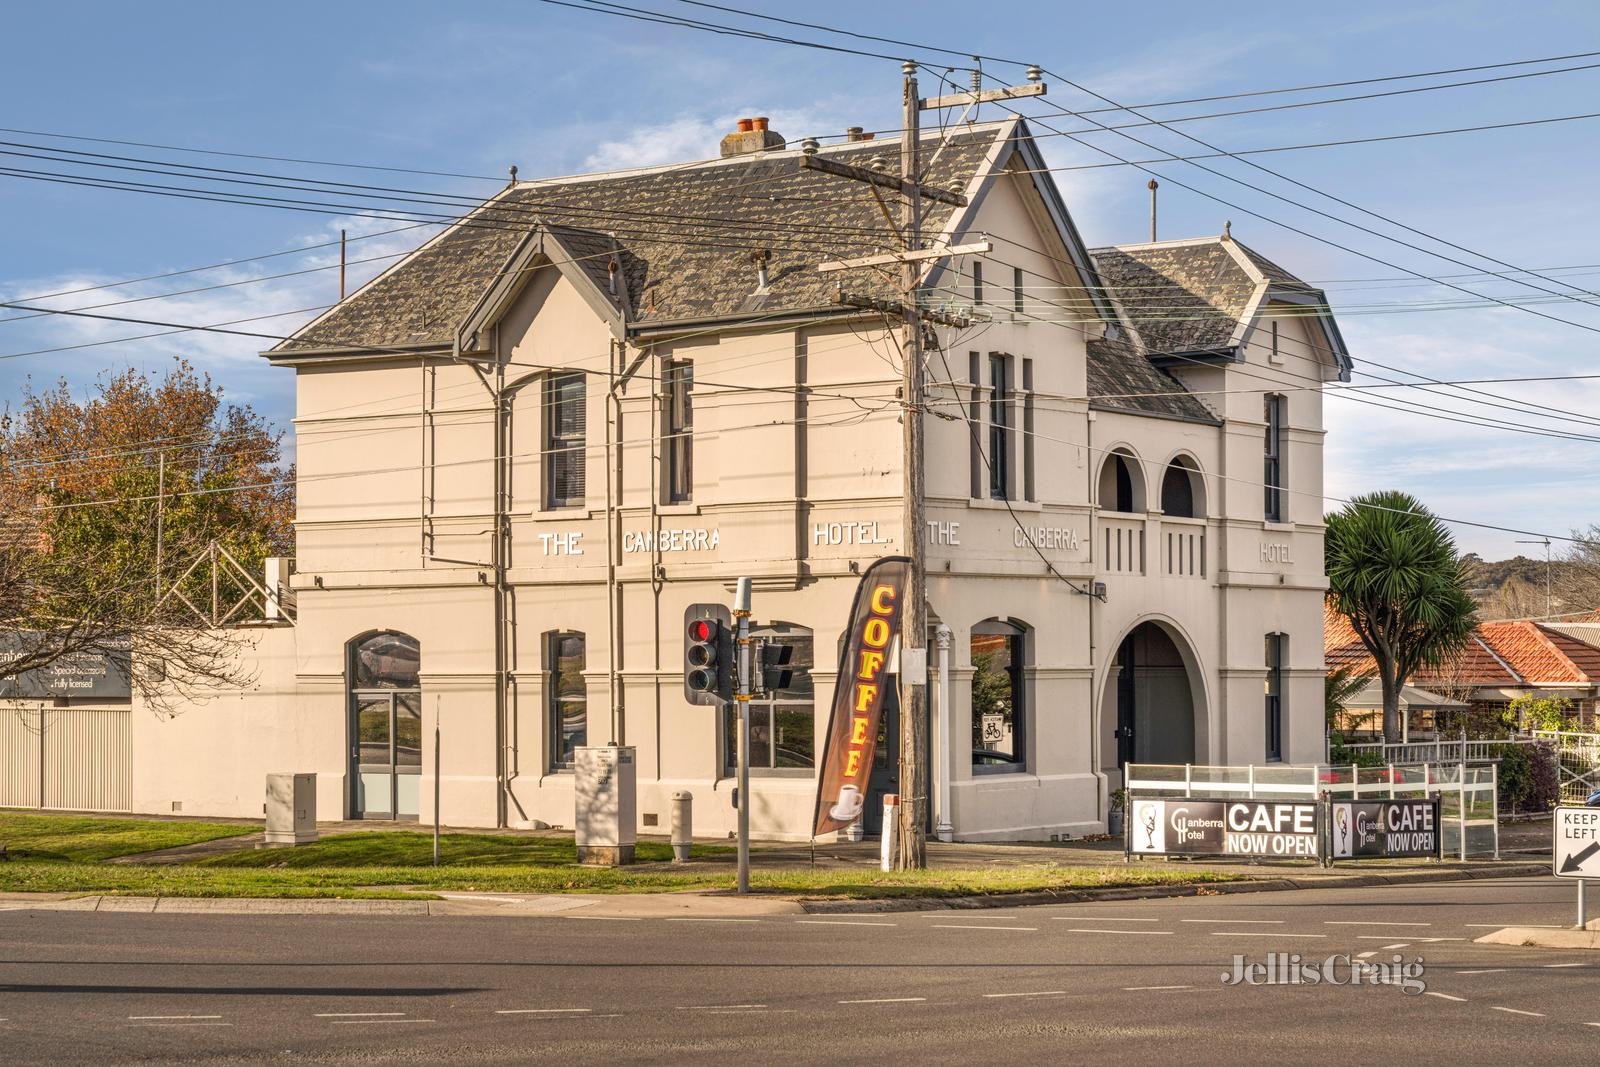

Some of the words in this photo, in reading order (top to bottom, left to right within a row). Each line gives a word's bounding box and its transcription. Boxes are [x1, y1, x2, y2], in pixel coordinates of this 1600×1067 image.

[538, 532, 584, 555] THE
[623, 528, 720, 552] CANBERRA
[926, 521, 960, 545] THE
[1014, 526, 1078, 550] CANBERRA
[1259, 543, 1294, 564] HOTEL
[54, 678, 68, 690] Fully
[69, 677, 93, 688] licensed
[843, 584, 896, 778] COFFEE
[1171, 807, 1224, 833] Canberra
[1228, 803, 1314, 833] CAFE
[1387, 804, 1434, 832] CAFE
[1564, 813, 1598, 825] KEEP
[1228, 834, 1268, 853] NOW
[1272, 835, 1317, 855] OPEN
[1387, 833, 1410, 852] NOW
[1412, 832, 1434, 851] OPEN
[1565, 827, 1597, 839] LEFT
